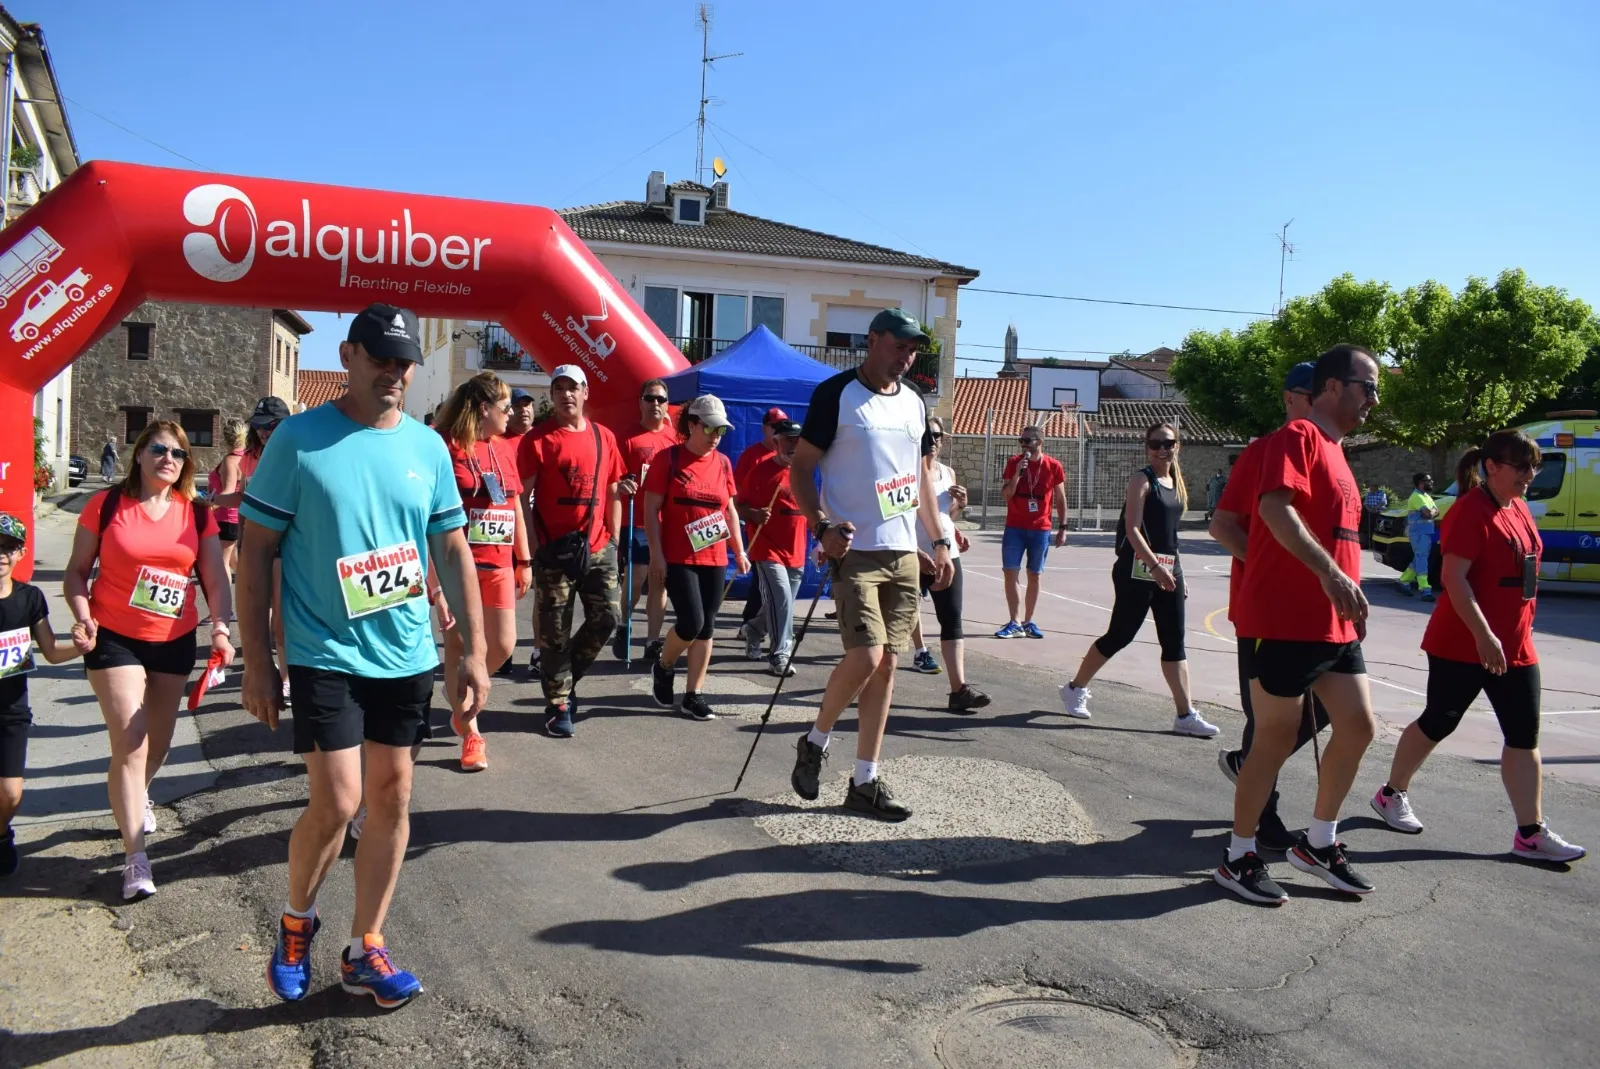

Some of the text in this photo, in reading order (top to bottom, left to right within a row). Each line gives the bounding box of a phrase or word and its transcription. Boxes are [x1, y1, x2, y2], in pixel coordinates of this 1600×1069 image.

[265, 199, 492, 287] alquiber
[349, 276, 472, 296] Renting Flexible
[22, 283, 113, 361] www.alquiber.es
[541, 310, 609, 383] www.alquiber.es
[877, 474, 916, 494] bedunia
[888, 486, 911, 506] 149
[471, 511, 514, 522] bedunia
[480, 521, 506, 536] 154
[697, 524, 721, 541] 163
[339, 547, 418, 580] bedunia
[360, 565, 409, 598] 124
[149, 585, 180, 607] 135
[0, 646, 23, 667] 73
